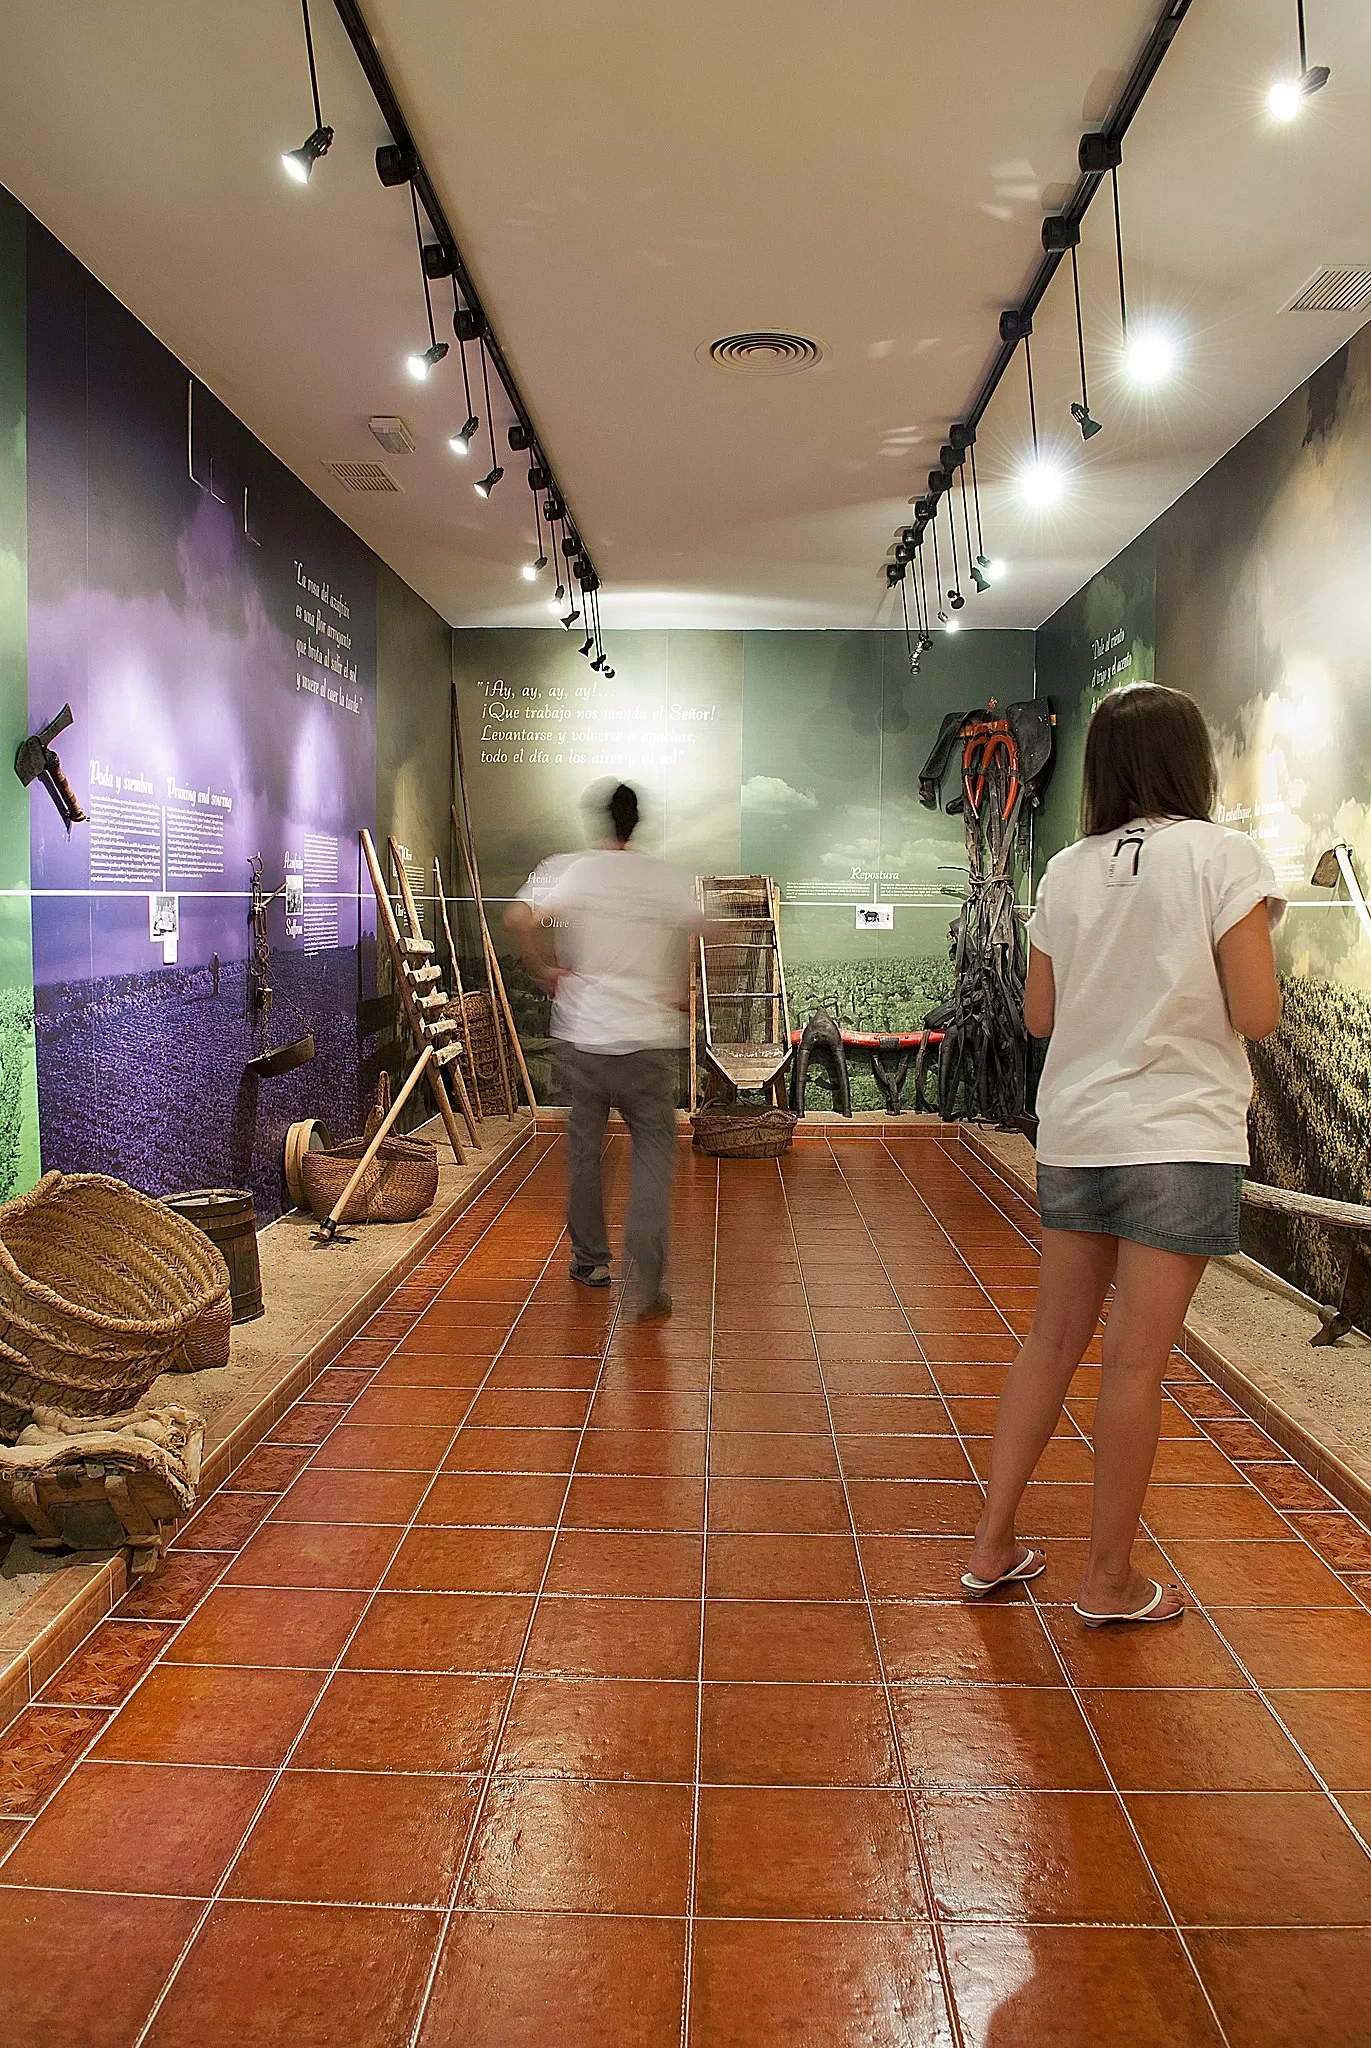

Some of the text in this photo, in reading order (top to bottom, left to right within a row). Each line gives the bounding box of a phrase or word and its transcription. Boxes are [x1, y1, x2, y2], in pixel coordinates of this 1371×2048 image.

[321, 581, 329, 605] del
[295, 604, 302, 620] es
[315, 608, 327, 636] flor
[327, 624, 353, 651] arrogante
[1105, 632, 1111, 653] al
[295, 639, 307, 658] que
[307, 636, 323, 665] brota
[323, 647, 331, 669] al
[343, 659, 349, 679] el
[349, 664, 358, 684] sol
[1091, 668, 1097, 688] el
[1107, 667, 1112, 683] y
[1111, 655, 1117, 676] el
[296, 672, 301, 692] y
[302, 675, 320, 695] muere
[320, 677, 327, 699] al
[327, 688, 339, 704] caer
[339, 686, 345, 707] la
[477, 679, 516, 701] "¡Ay,
[521, 686, 542, 701] ay,
[548, 686, 569, 701] ay,
[481, 701, 717, 722] ¡Que trabajo nos manda el Señor!
[480, 724, 553, 742] Levantarse
[557, 731, 567, 744] y
[571, 727, 625, 742] volverse
[481, 748, 509, 764] todo
[512, 747, 524, 763] el
[528, 748, 550, 764] día
[555, 753, 564, 763] a
[568, 748, 587, 764] los
[591, 749, 624, 765] aires
[627, 754, 637, 769] y
[640, 747, 654, 765] el
[90, 759, 153, 795] Poda y siembra
[166, 775, 233, 813] Pruning and sowing
[849, 867, 900, 882] Repostura
[540, 915, 570, 929] Olive
